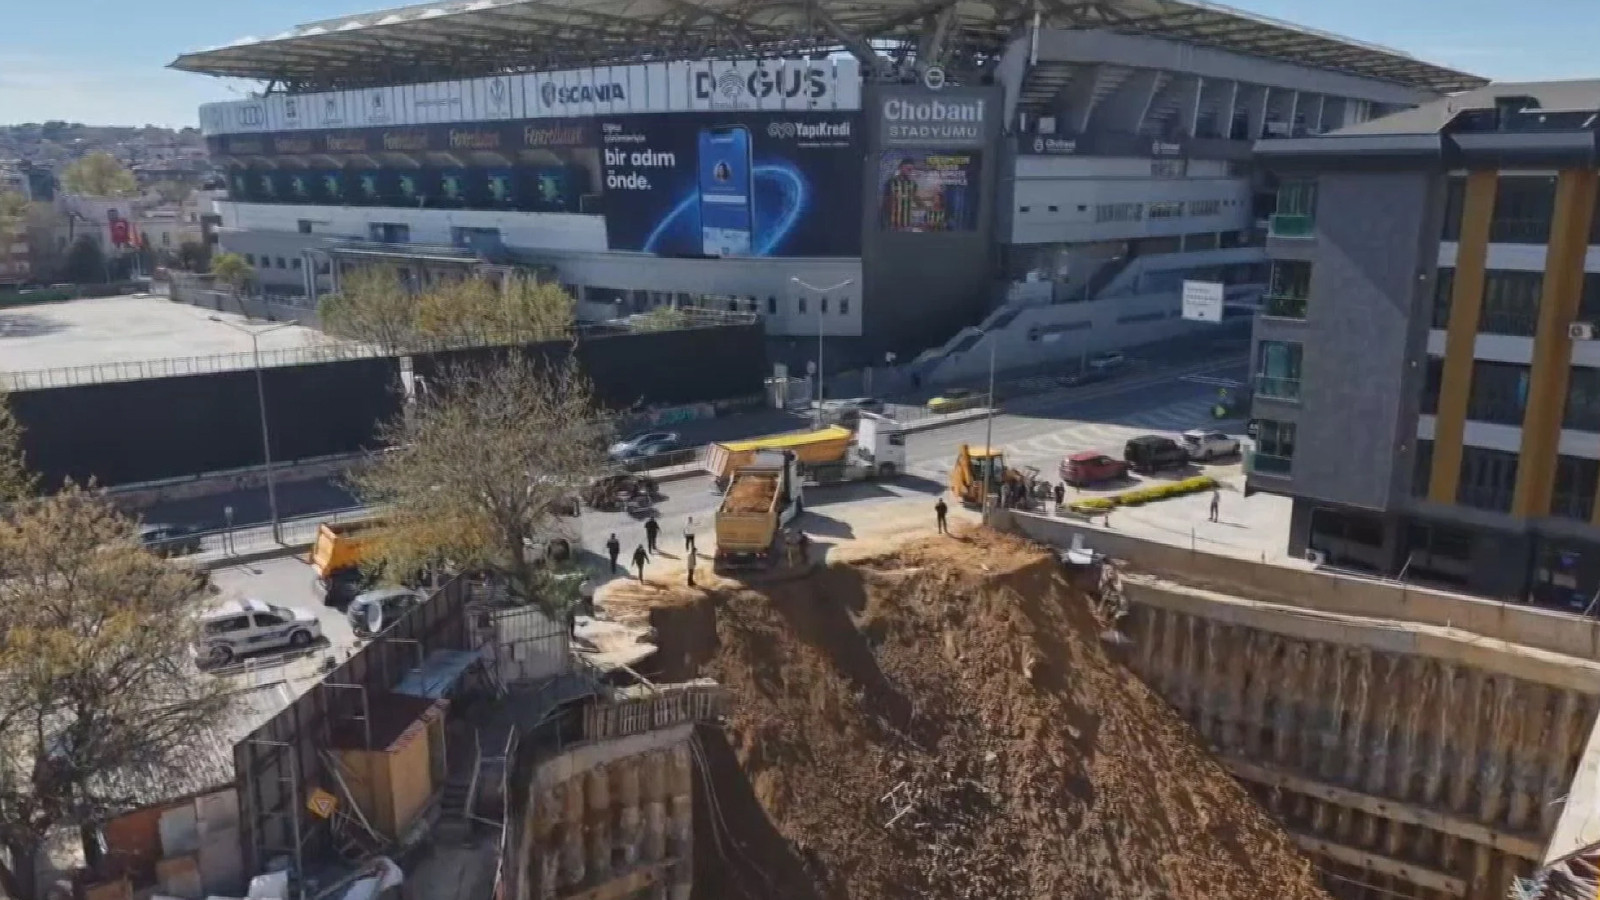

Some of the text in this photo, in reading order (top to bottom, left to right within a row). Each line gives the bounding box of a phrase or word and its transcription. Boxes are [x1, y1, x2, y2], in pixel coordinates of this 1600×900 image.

[558, 83, 625, 104] SCANIA
[884, 98, 983, 122] Chobani
[889, 126, 978, 138] STADYUMU
[604, 148, 676, 167] bir adım
[606, 169, 652, 190] önde.
